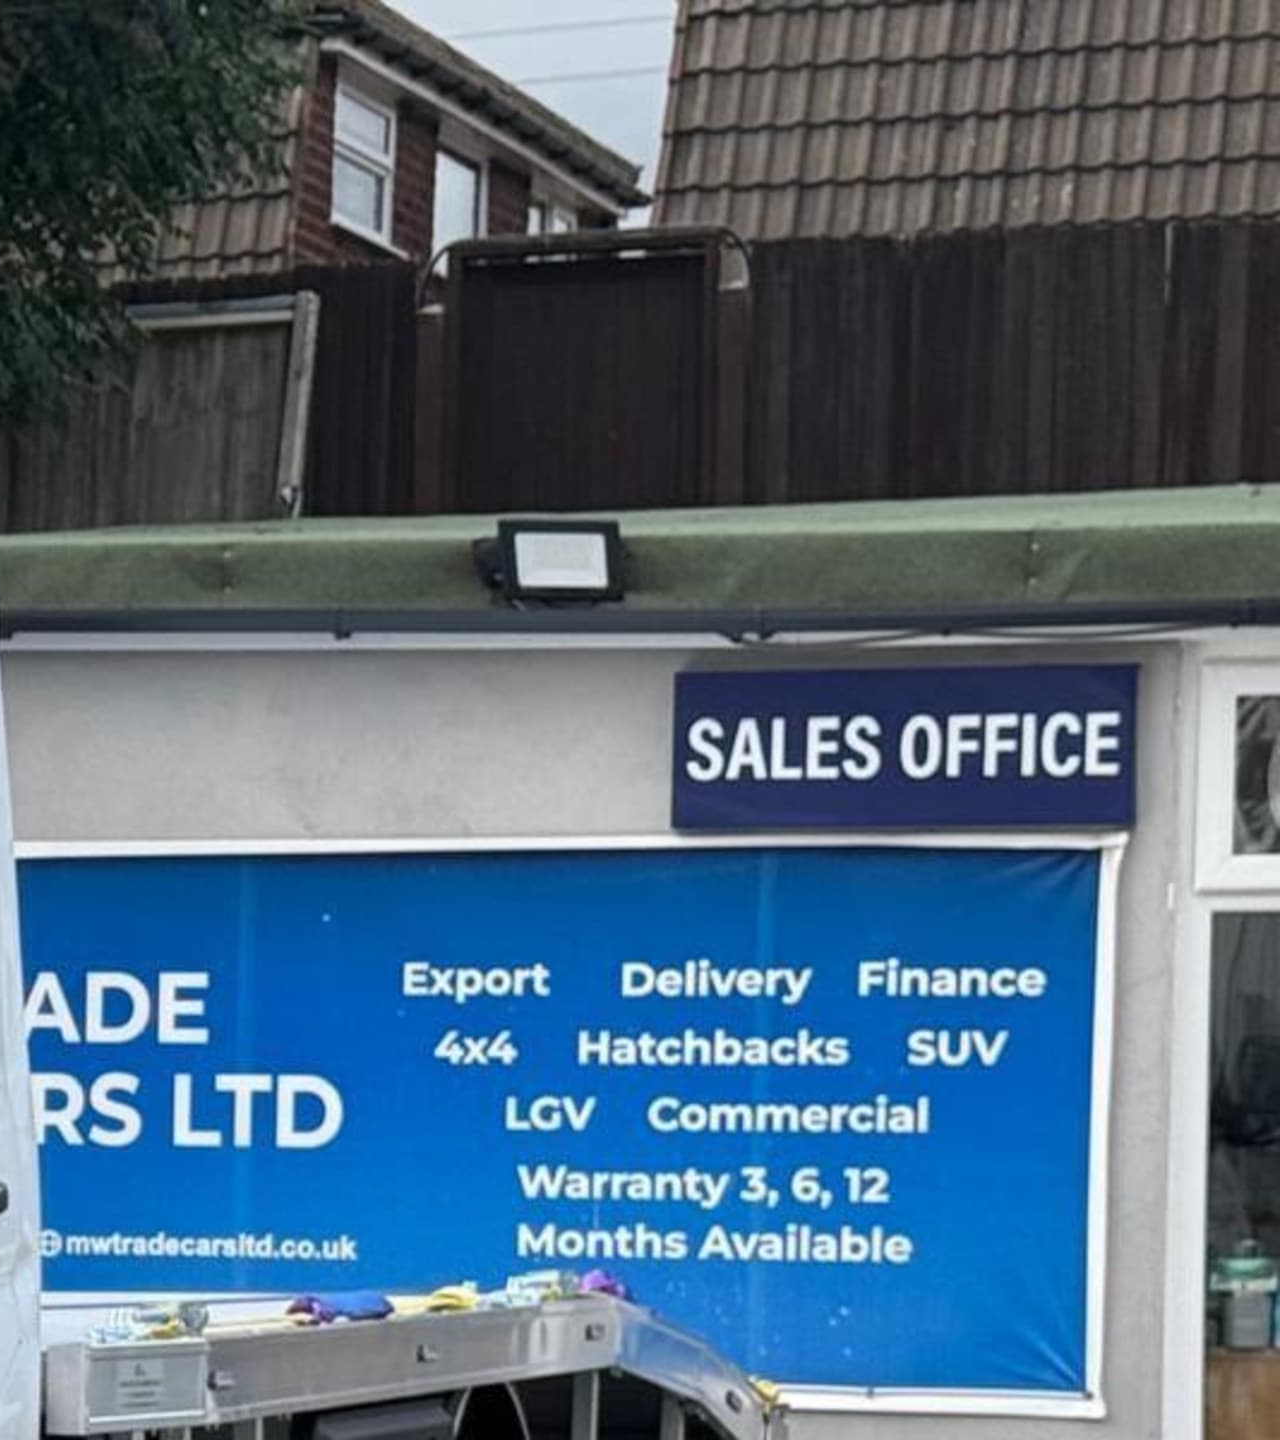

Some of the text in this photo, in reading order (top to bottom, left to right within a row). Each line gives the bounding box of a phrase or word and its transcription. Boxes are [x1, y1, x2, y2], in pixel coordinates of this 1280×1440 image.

[687, 712, 1120, 781] SALES OFFICE
[403, 958, 1046, 1004] Export Delivery Finance
[25, 971, 209, 1044] ADE
[435, 1029, 1008, 1065] 4x4 Hatchbacks SUV
[30, 1072, 343, 1148] RS LTD
[506, 1095, 928, 1133] LGV Commercial
[518, 1165, 888, 1209] Warranty 3, 6, 12
[66, 1232, 356, 1260] mwtradecarsltd.co.uk
[518, 1224, 911, 1263] Months Available
